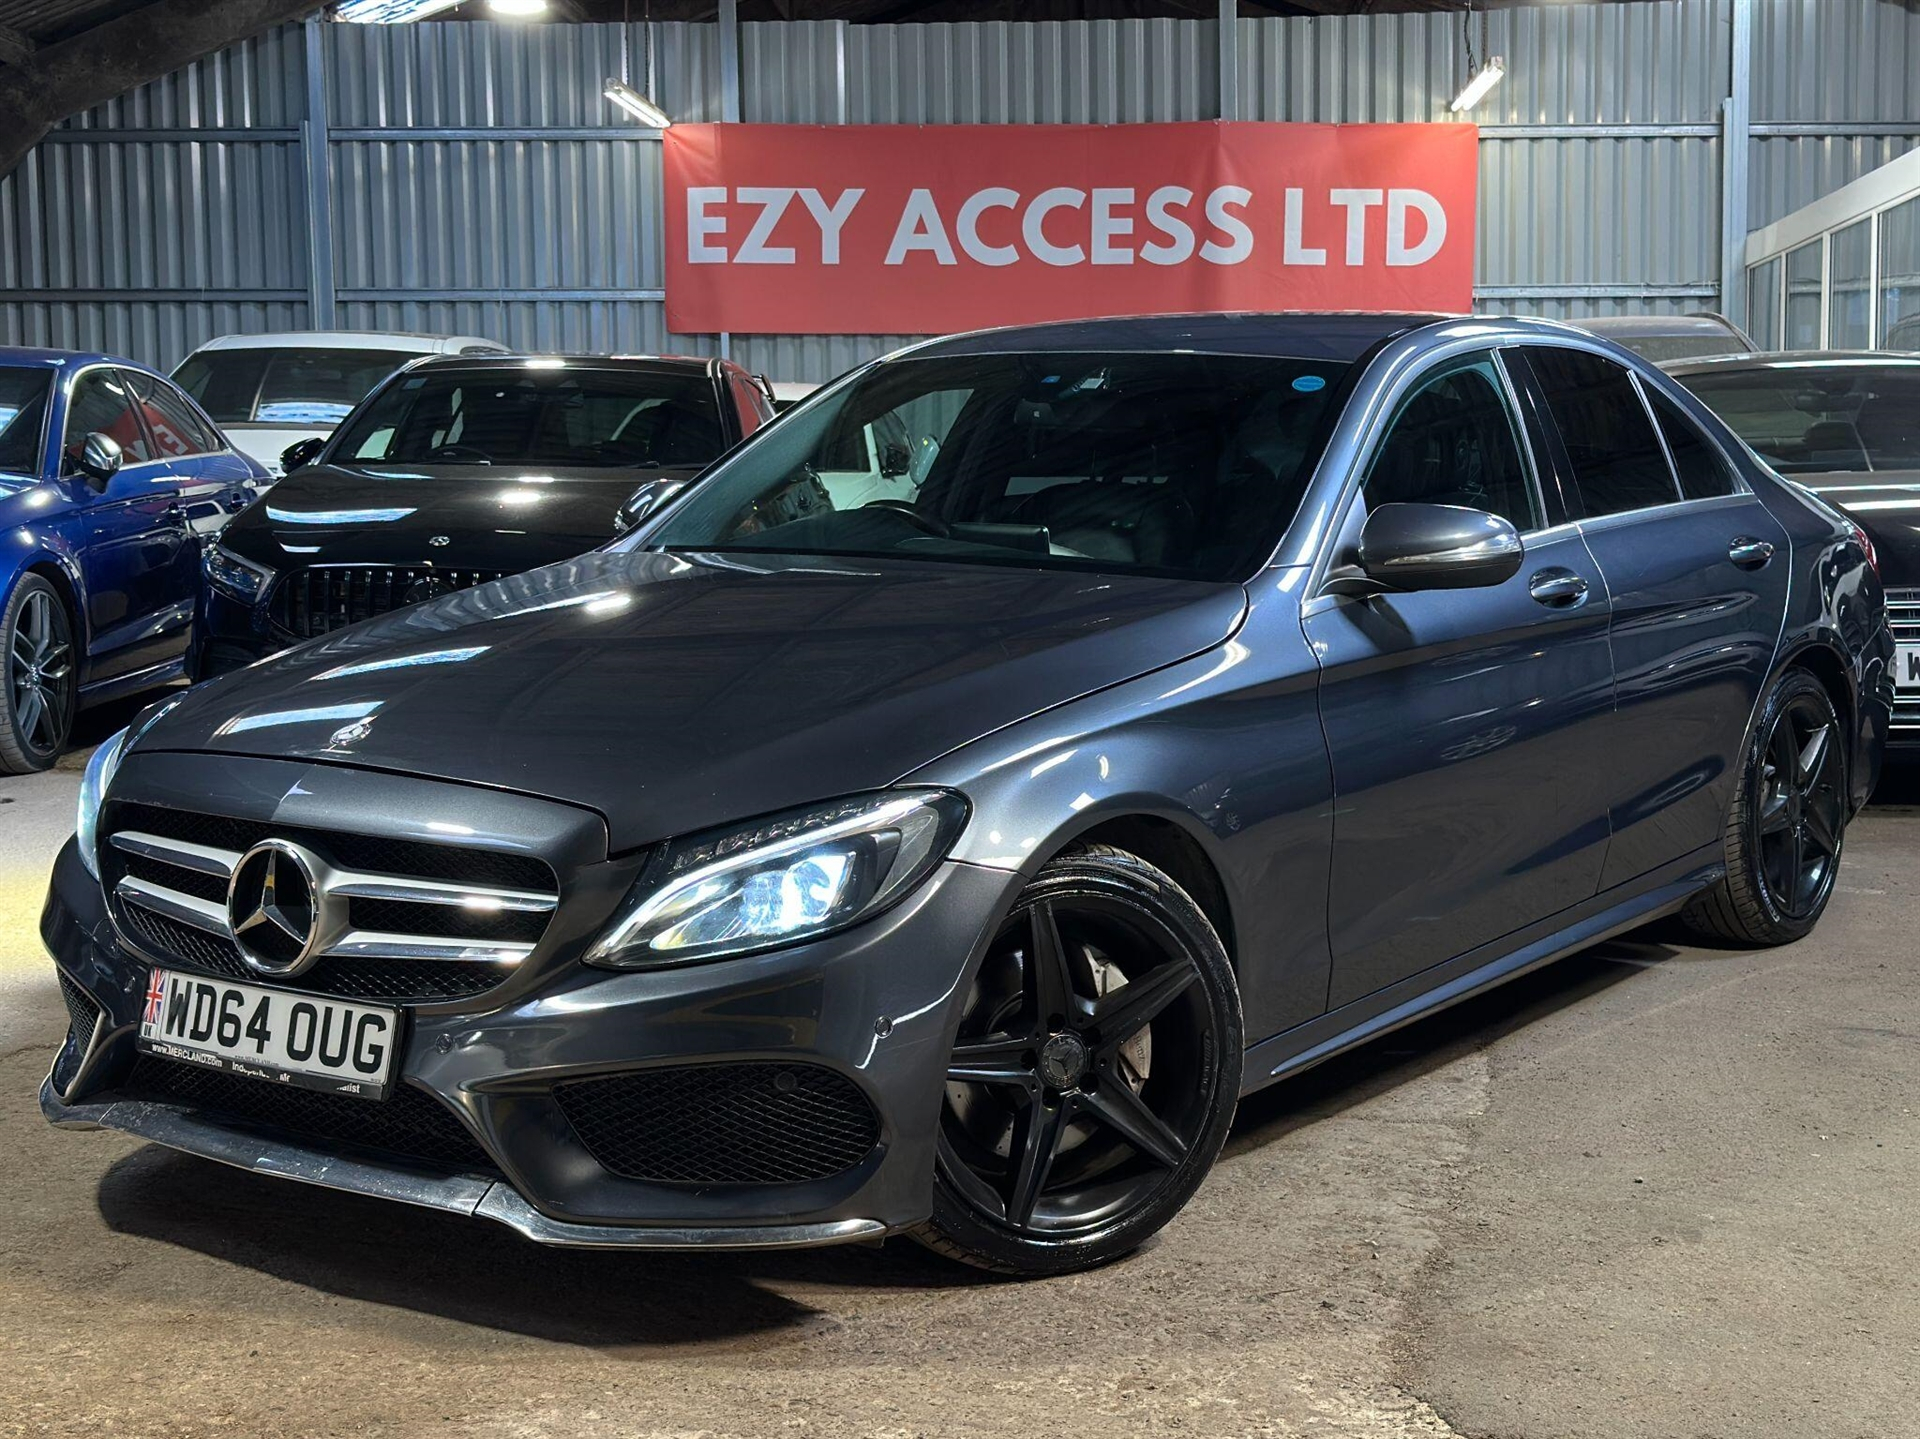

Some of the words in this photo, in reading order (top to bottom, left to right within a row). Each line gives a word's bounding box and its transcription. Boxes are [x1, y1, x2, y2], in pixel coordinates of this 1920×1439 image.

[686, 187, 865, 265] EZY
[884, 187, 1255, 266] ACCESS
[1284, 187, 1448, 266] LTD
[165, 978, 271, 1054] WD64
[286, 1002, 387, 1074] OUG
